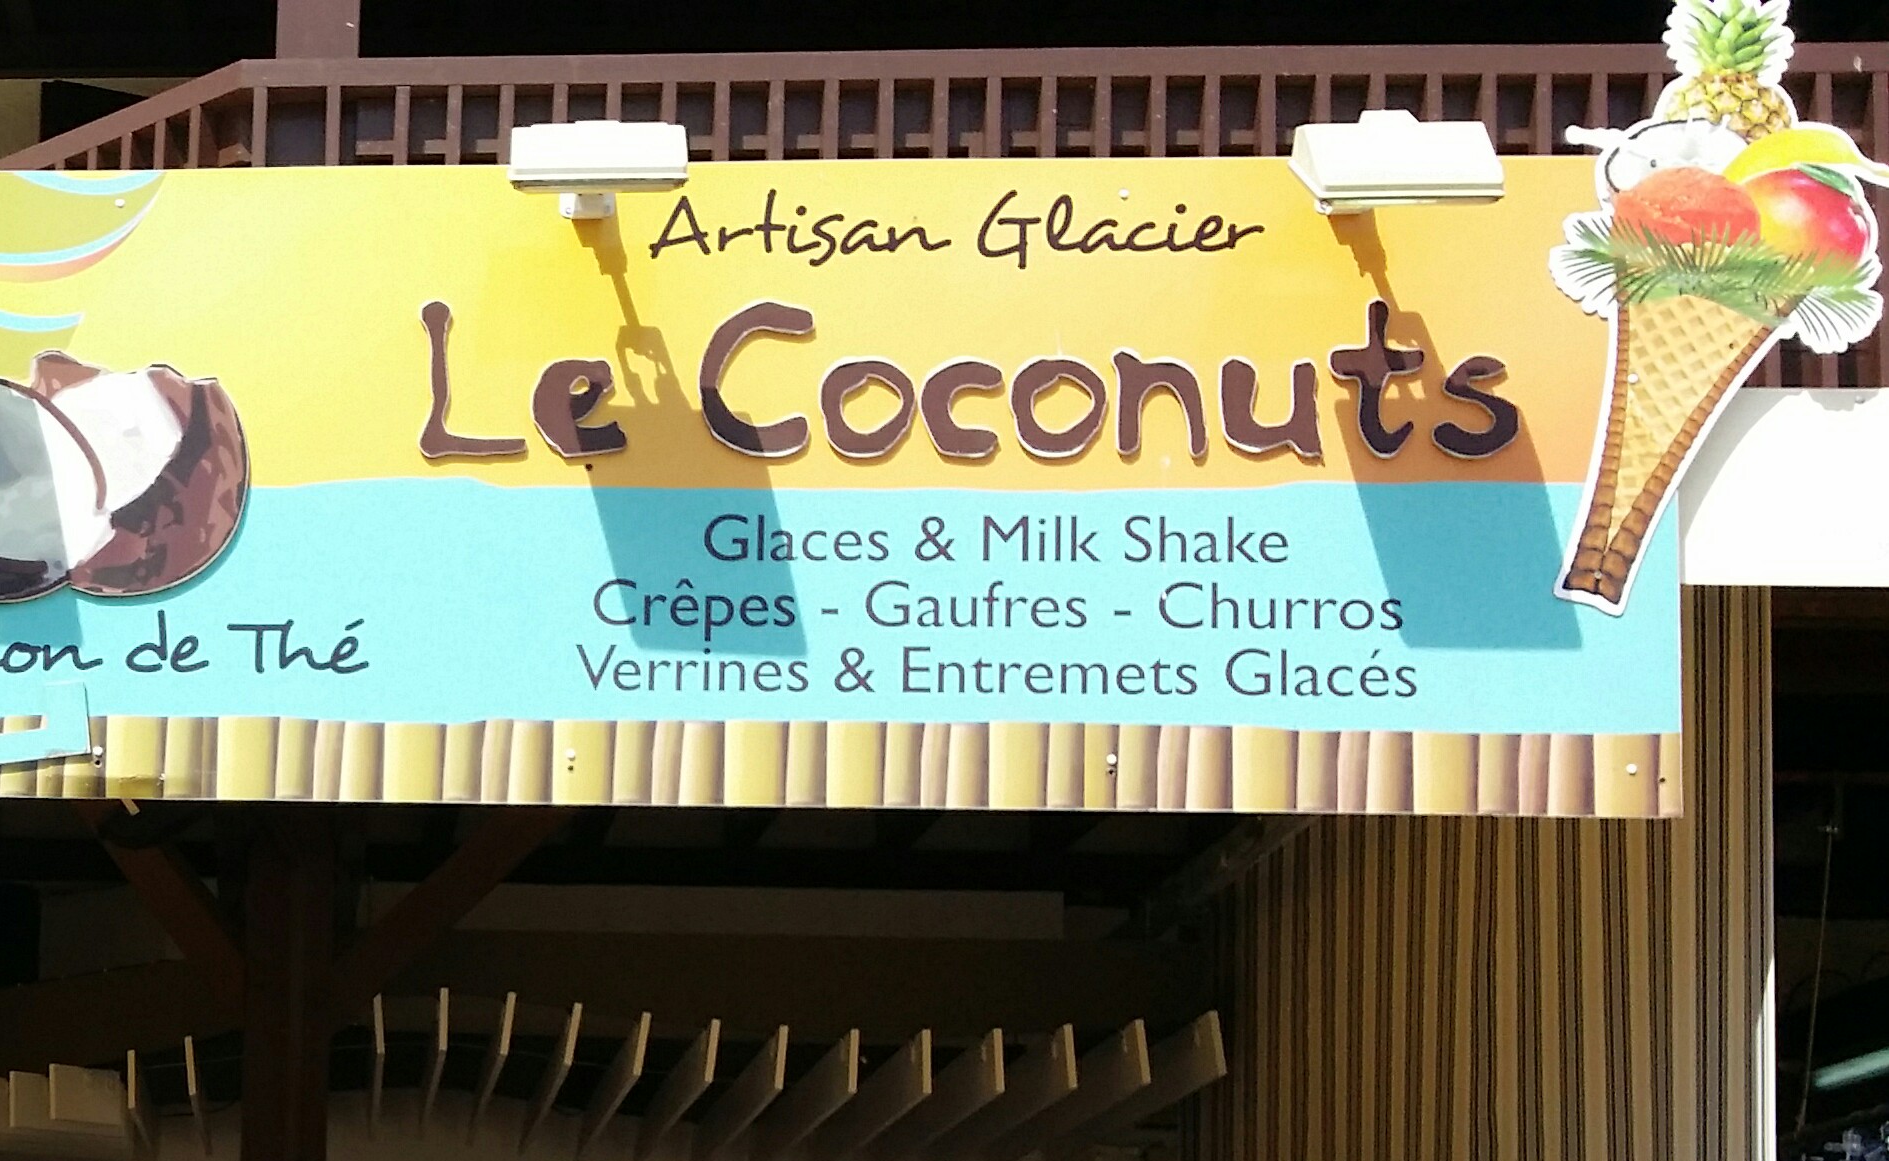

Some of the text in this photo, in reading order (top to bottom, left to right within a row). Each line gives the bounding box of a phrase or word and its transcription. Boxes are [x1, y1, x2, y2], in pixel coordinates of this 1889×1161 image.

[649, 189, 1265, 269] Artisan Glacier
[420, 294, 1526, 465] Le Coconuts
[704, 514, 1288, 563] Glaces & Milk Shake
[594, 576, 796, 642] Crêpes
[866, 580, 1086, 628] Gaufres
[1159, 577, 1407, 637] Churros
[126, 610, 209, 672] de
[227, 619, 369, 674] Thé
[576, 640, 1422, 699] Verrines & Entremets Glacés
